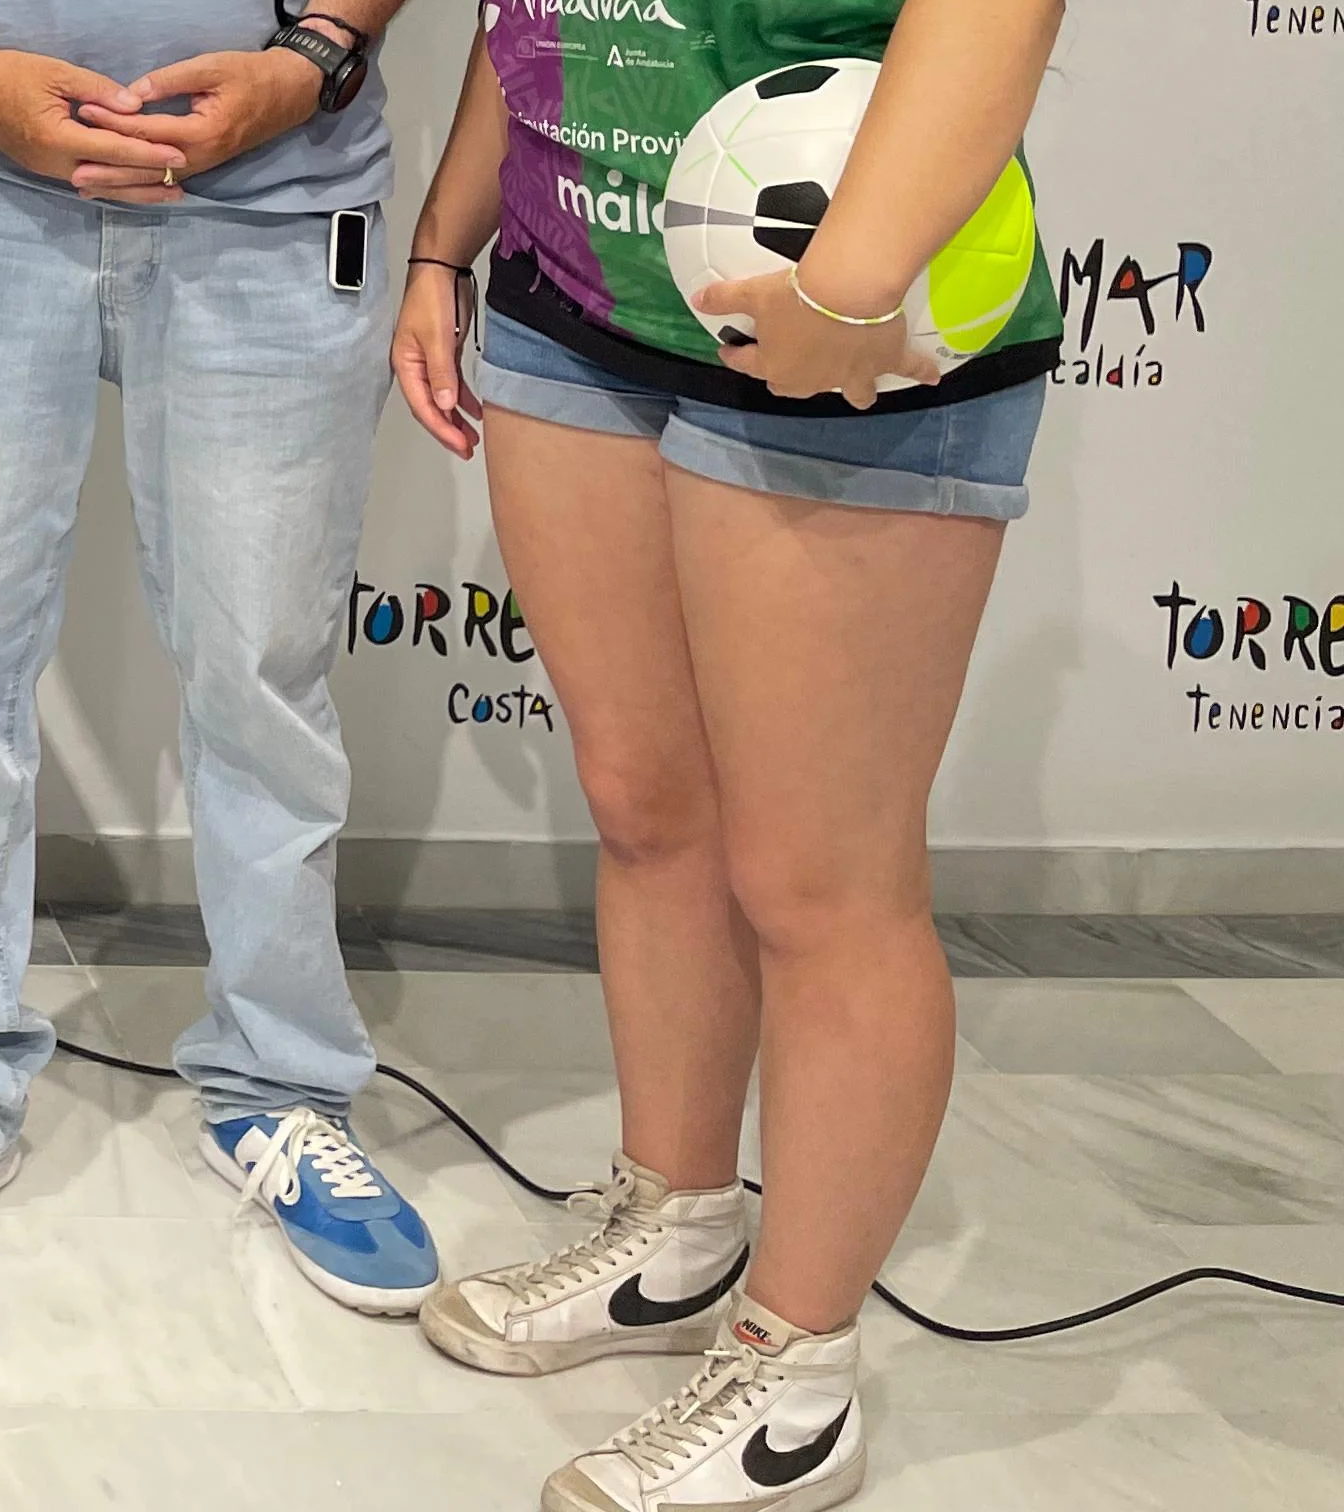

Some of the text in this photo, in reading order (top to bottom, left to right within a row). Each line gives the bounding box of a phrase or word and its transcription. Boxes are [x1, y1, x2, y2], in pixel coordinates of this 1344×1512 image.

[613, 128, 688, 155] Provi
[1060, 238, 1212, 352] MAR
[449, 683, 553, 732] Costa
[742, 1318, 772, 1341] NIKE
